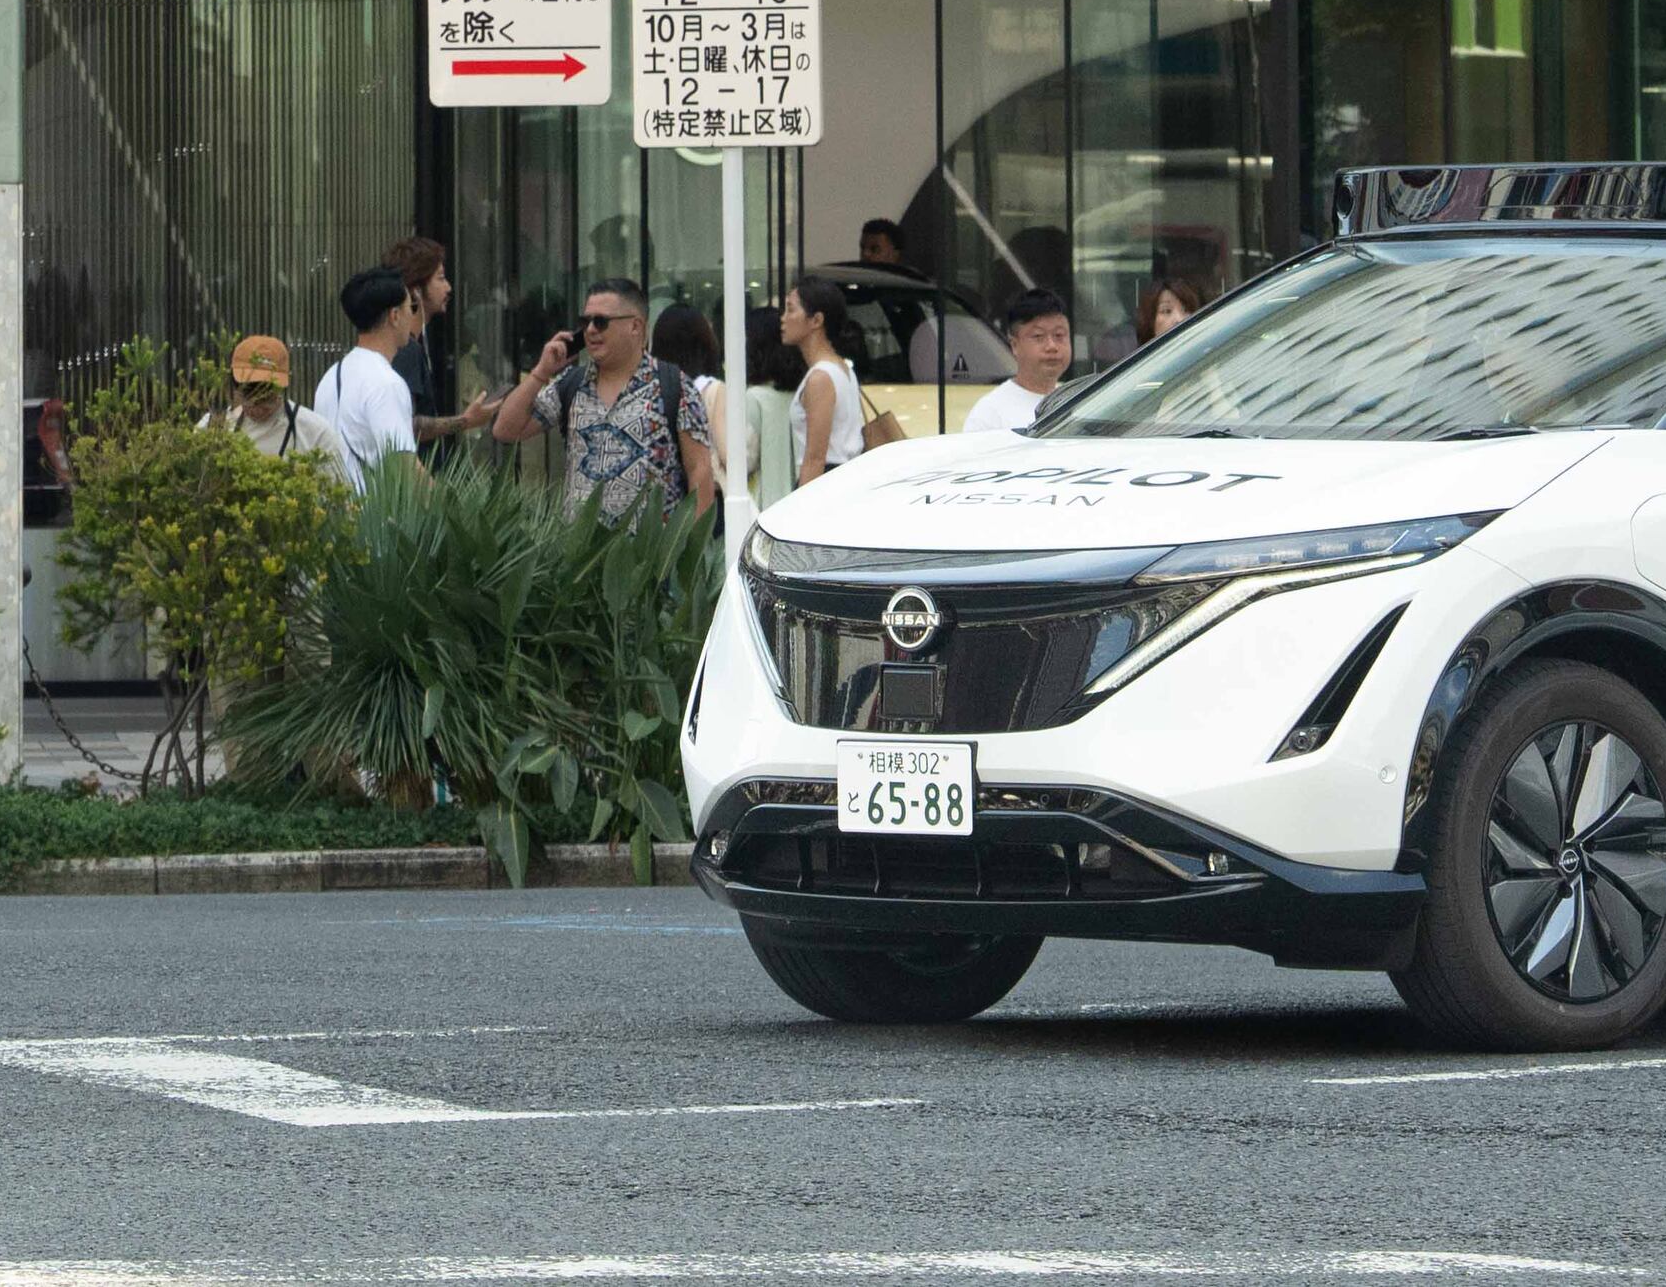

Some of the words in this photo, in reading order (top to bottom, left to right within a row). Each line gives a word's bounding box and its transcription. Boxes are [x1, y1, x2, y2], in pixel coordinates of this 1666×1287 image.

[440, 10, 515, 44] を除く
[882, 611, 939, 627] NISSAN
[847, 791, 861, 814] と
[867, 781, 965, 827] 65-88
